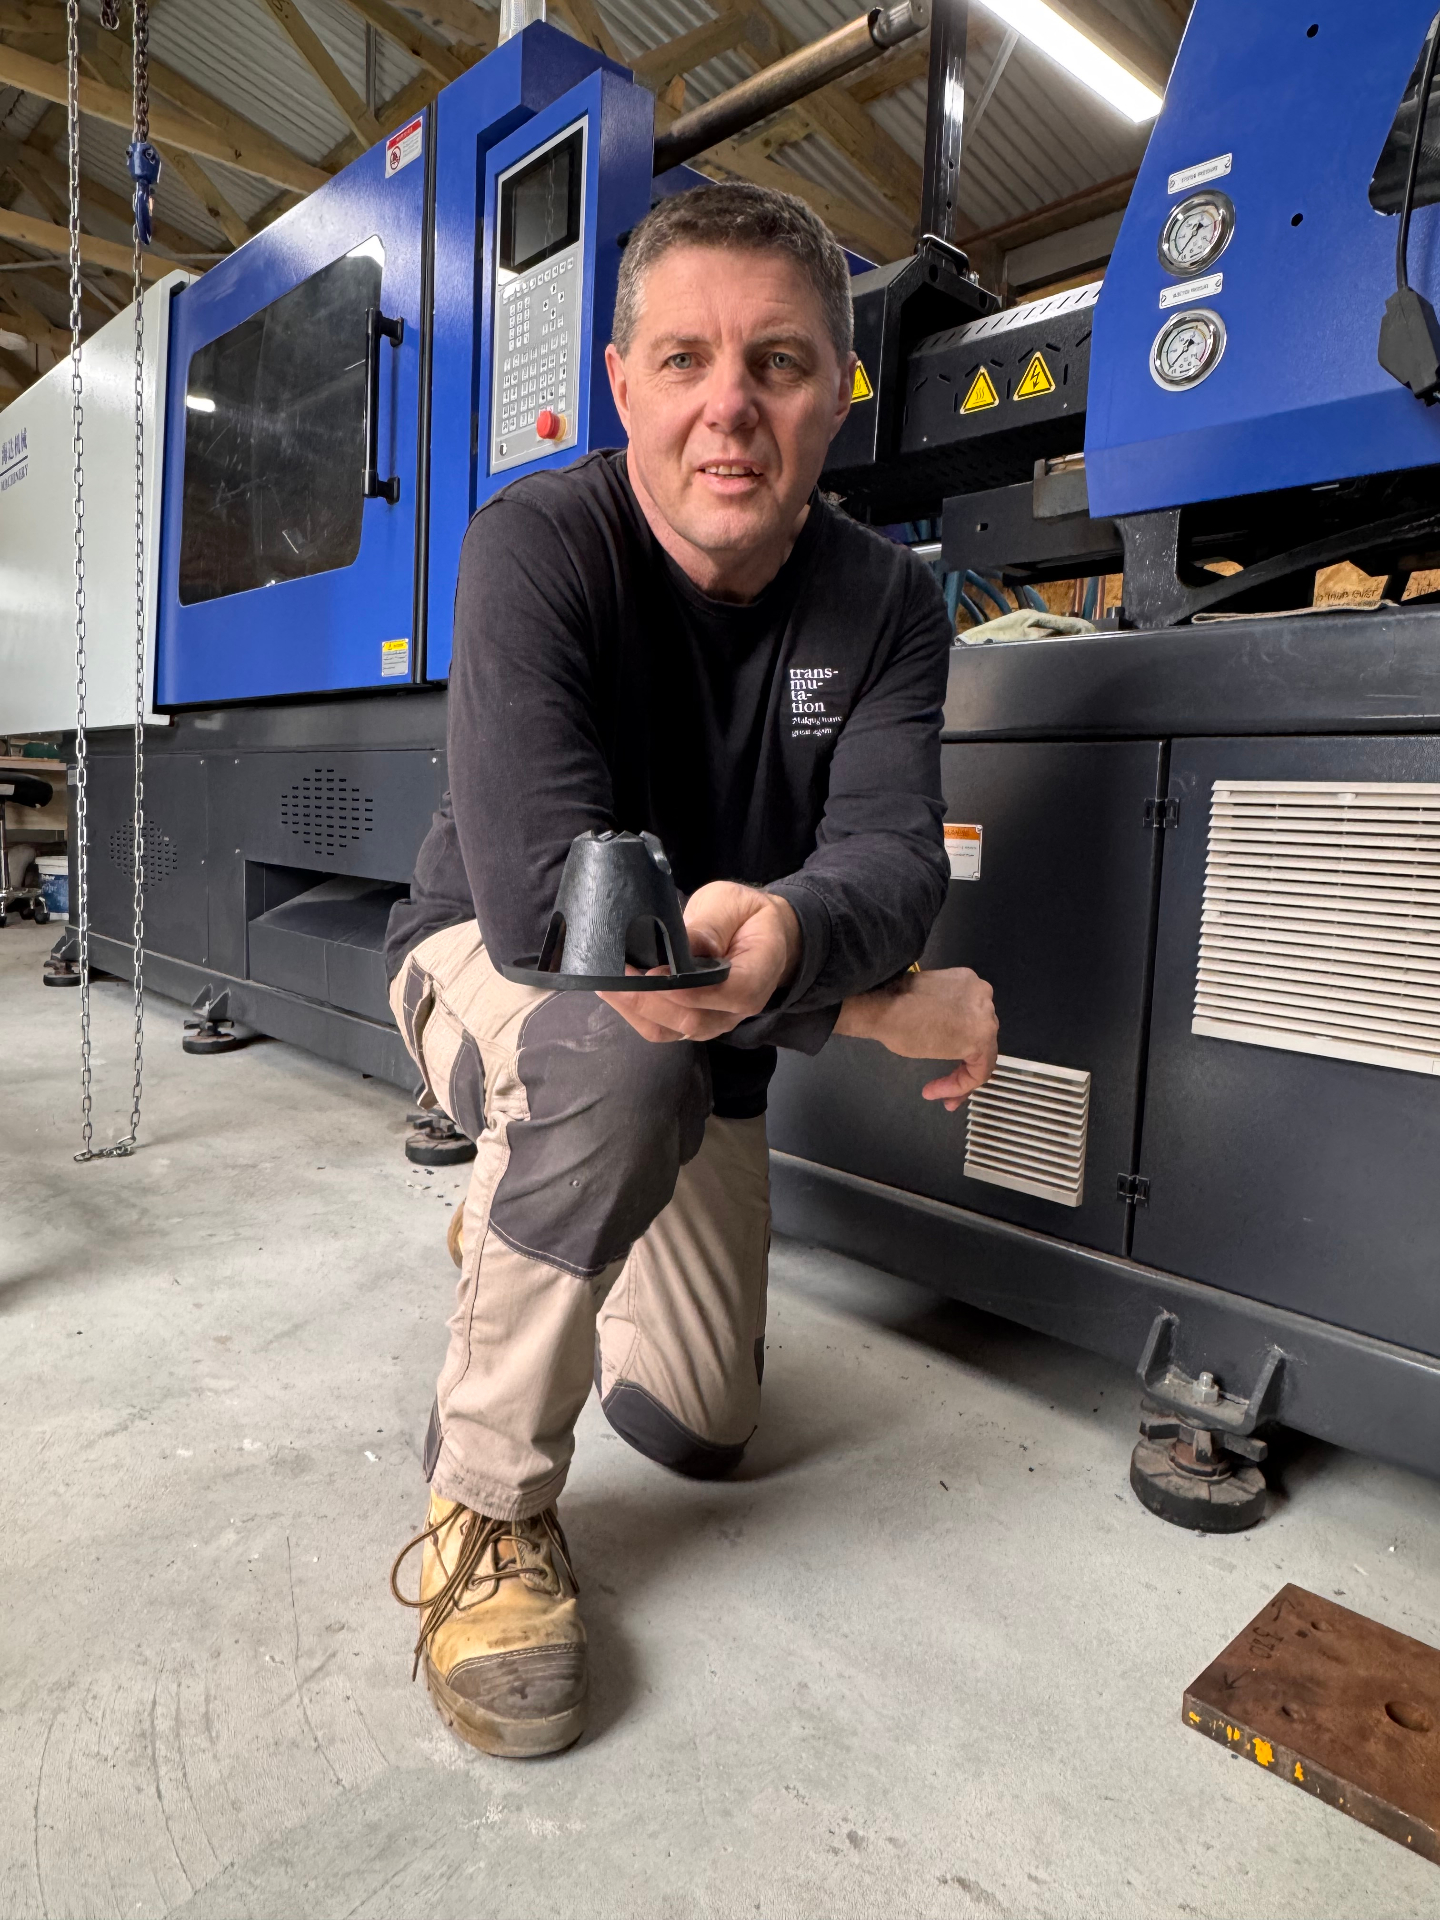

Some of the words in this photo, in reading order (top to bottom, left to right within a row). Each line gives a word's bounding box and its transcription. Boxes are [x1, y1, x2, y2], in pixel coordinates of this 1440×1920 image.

[790, 668, 839, 679] trans-
[790, 680, 824, 690] mu-
[791, 690, 813, 701] ta-
[792, 701, 826, 713] tion
